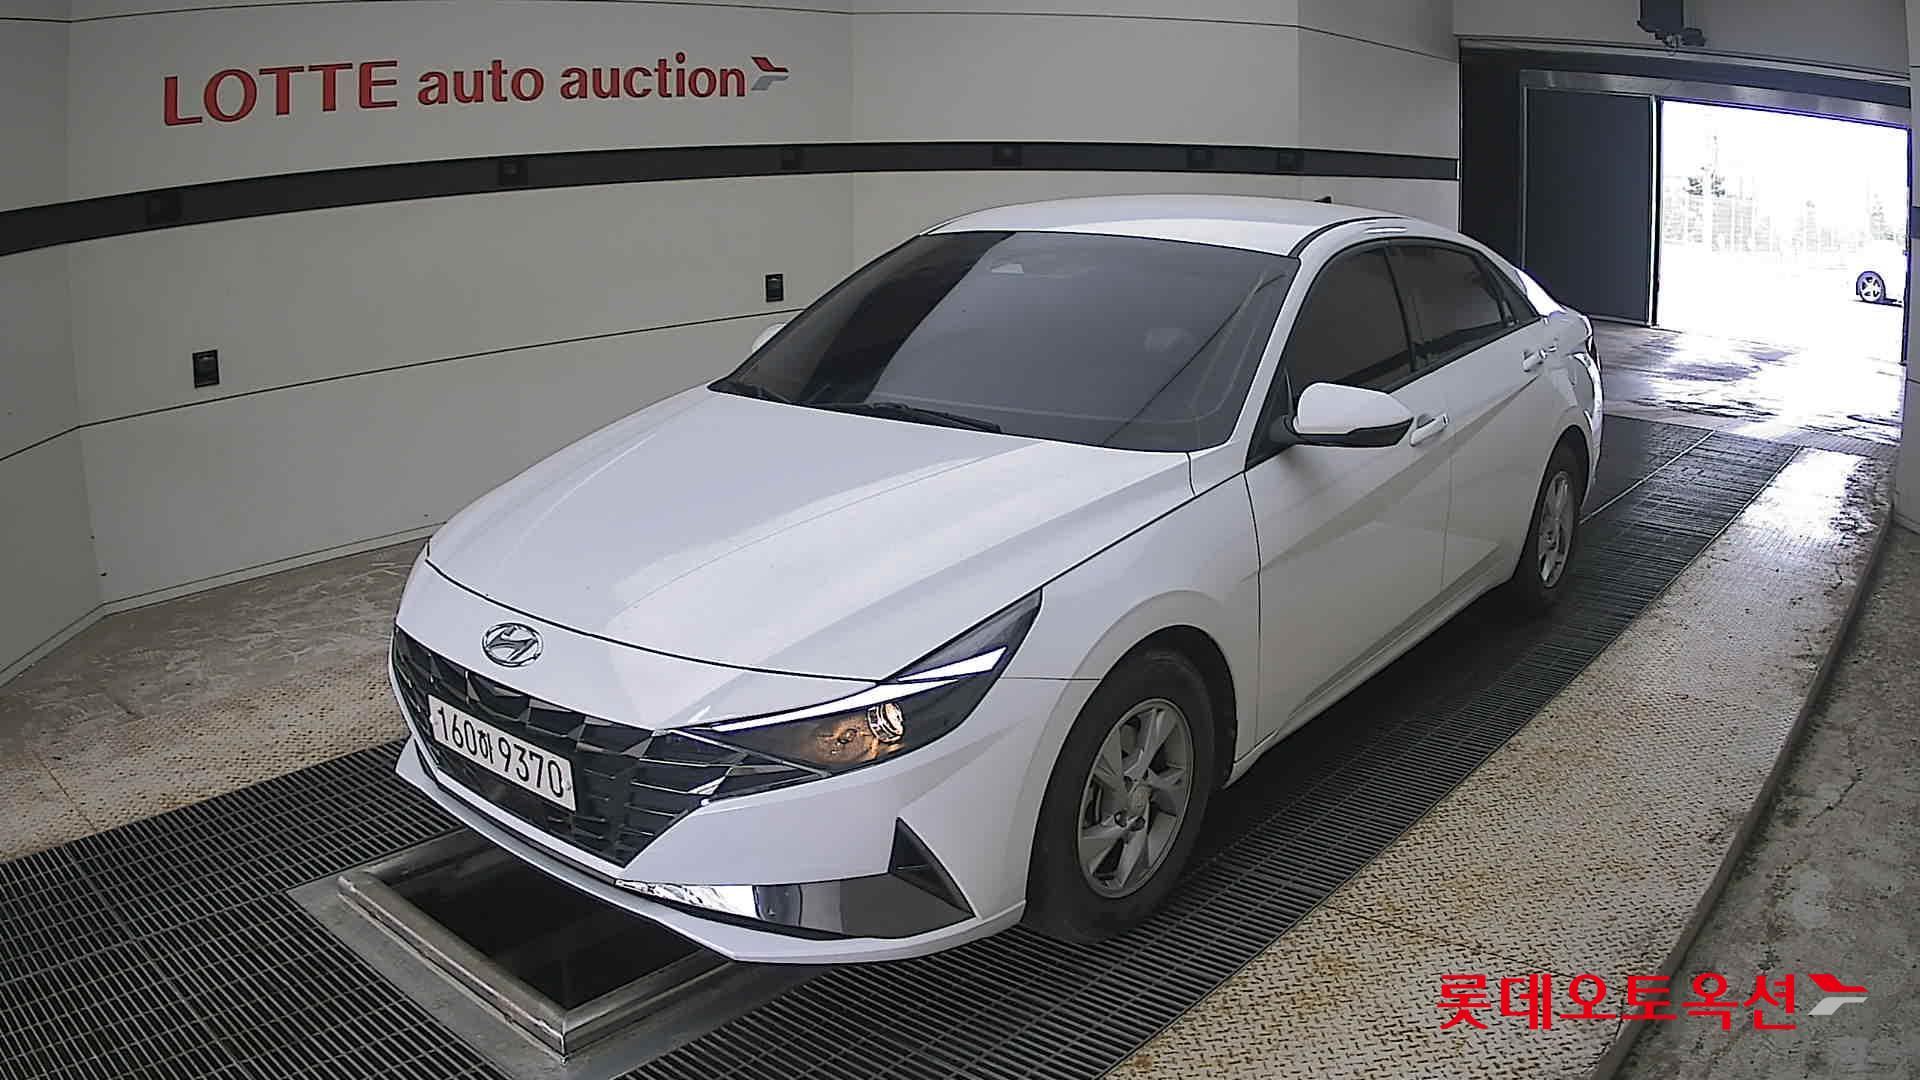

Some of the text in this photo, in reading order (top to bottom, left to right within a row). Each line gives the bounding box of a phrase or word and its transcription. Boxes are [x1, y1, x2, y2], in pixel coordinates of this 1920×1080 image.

[163, 52, 747, 126] LOTTE auto auction
